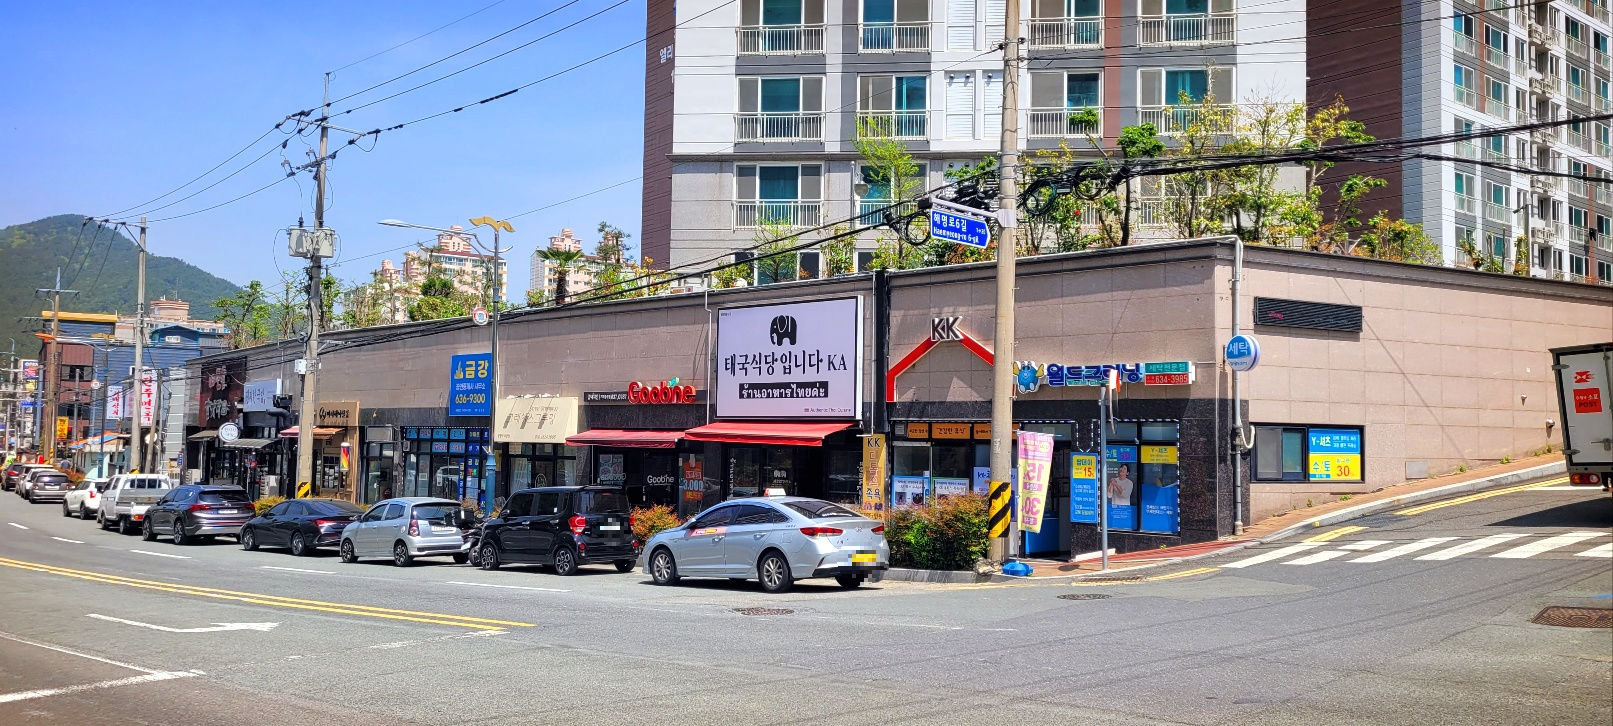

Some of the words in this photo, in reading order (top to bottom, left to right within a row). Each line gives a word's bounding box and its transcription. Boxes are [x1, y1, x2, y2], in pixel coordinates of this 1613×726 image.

[933, 212, 967, 232] 해명로6길
[933, 226, 967, 241] Haemyeong-ro
[967, 234, 979, 243] 6-gil
[931, 316, 963, 341] KK
[1228, 341, 1249, 355] 세탁
[465, 360, 489, 378] 금강
[724, 349, 823, 377] 태국식당입니다
[827, 353, 847, 371] KA
[1149, 363, 1186, 372] 세탁전문점
[1155, 374, 1188, 384] 634-3985
[455, 393, 486, 404] 636-9300
[741, 383, 825, 399] ร้านอาหารไทยค่ะ
[867, 437, 881, 448] KK
